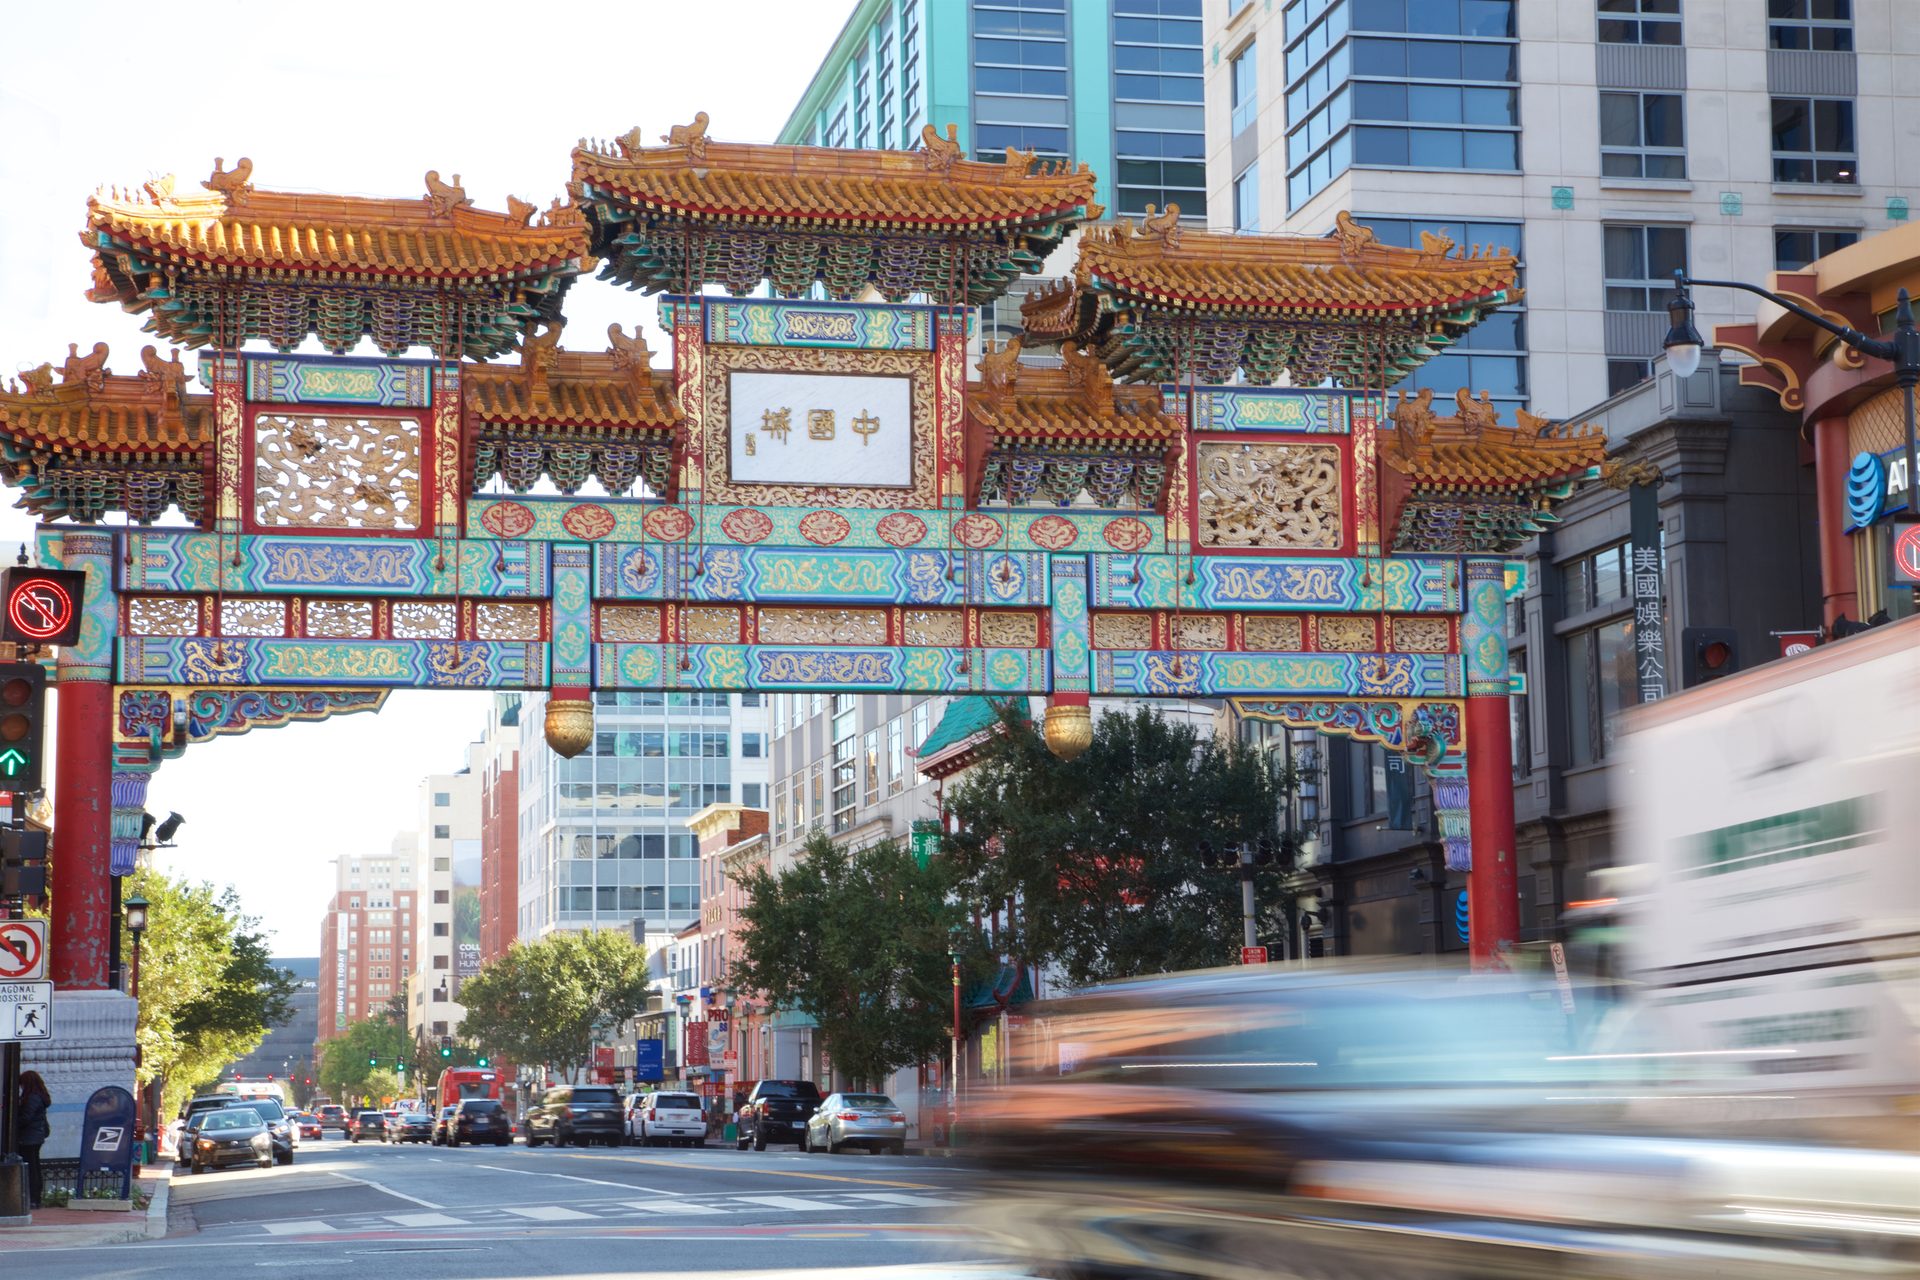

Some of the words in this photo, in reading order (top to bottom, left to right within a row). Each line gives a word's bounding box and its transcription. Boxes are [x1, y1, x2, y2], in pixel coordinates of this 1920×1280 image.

[460, 951, 476, 959] THE
[337, 953, 345, 977] TODAY
[337, 979, 345, 988] IN
[337, 990, 345, 1013] MOVE
[708, 1009, 729, 1022] PHO
